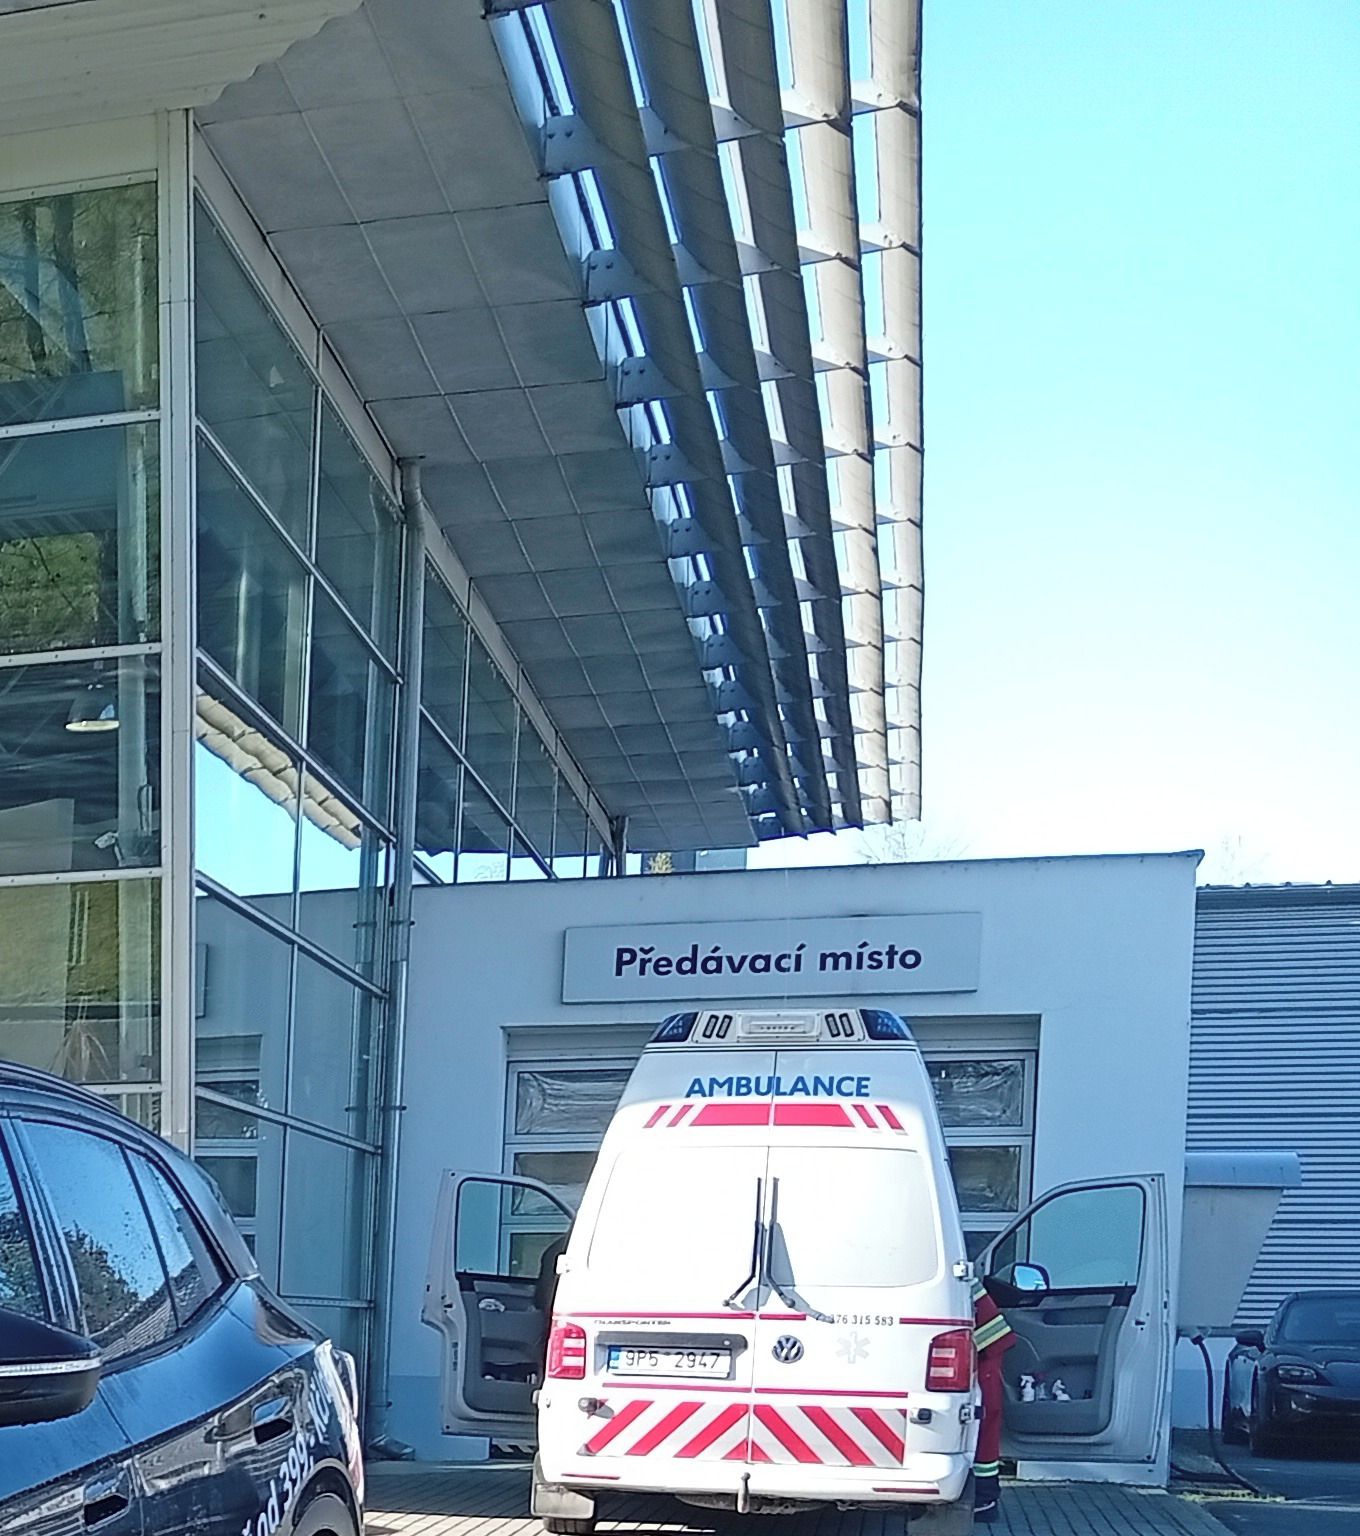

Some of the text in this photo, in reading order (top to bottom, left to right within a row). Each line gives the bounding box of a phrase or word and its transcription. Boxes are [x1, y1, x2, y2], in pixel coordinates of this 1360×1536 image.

[614, 941, 923, 977] Předávací místo
[684, 1075, 871, 1100] AMBULANCE
[851, 1314, 871, 1325] 315
[874, 1315, 894, 1326] 583
[624, 1350, 721, 1369] 9P5 2947
